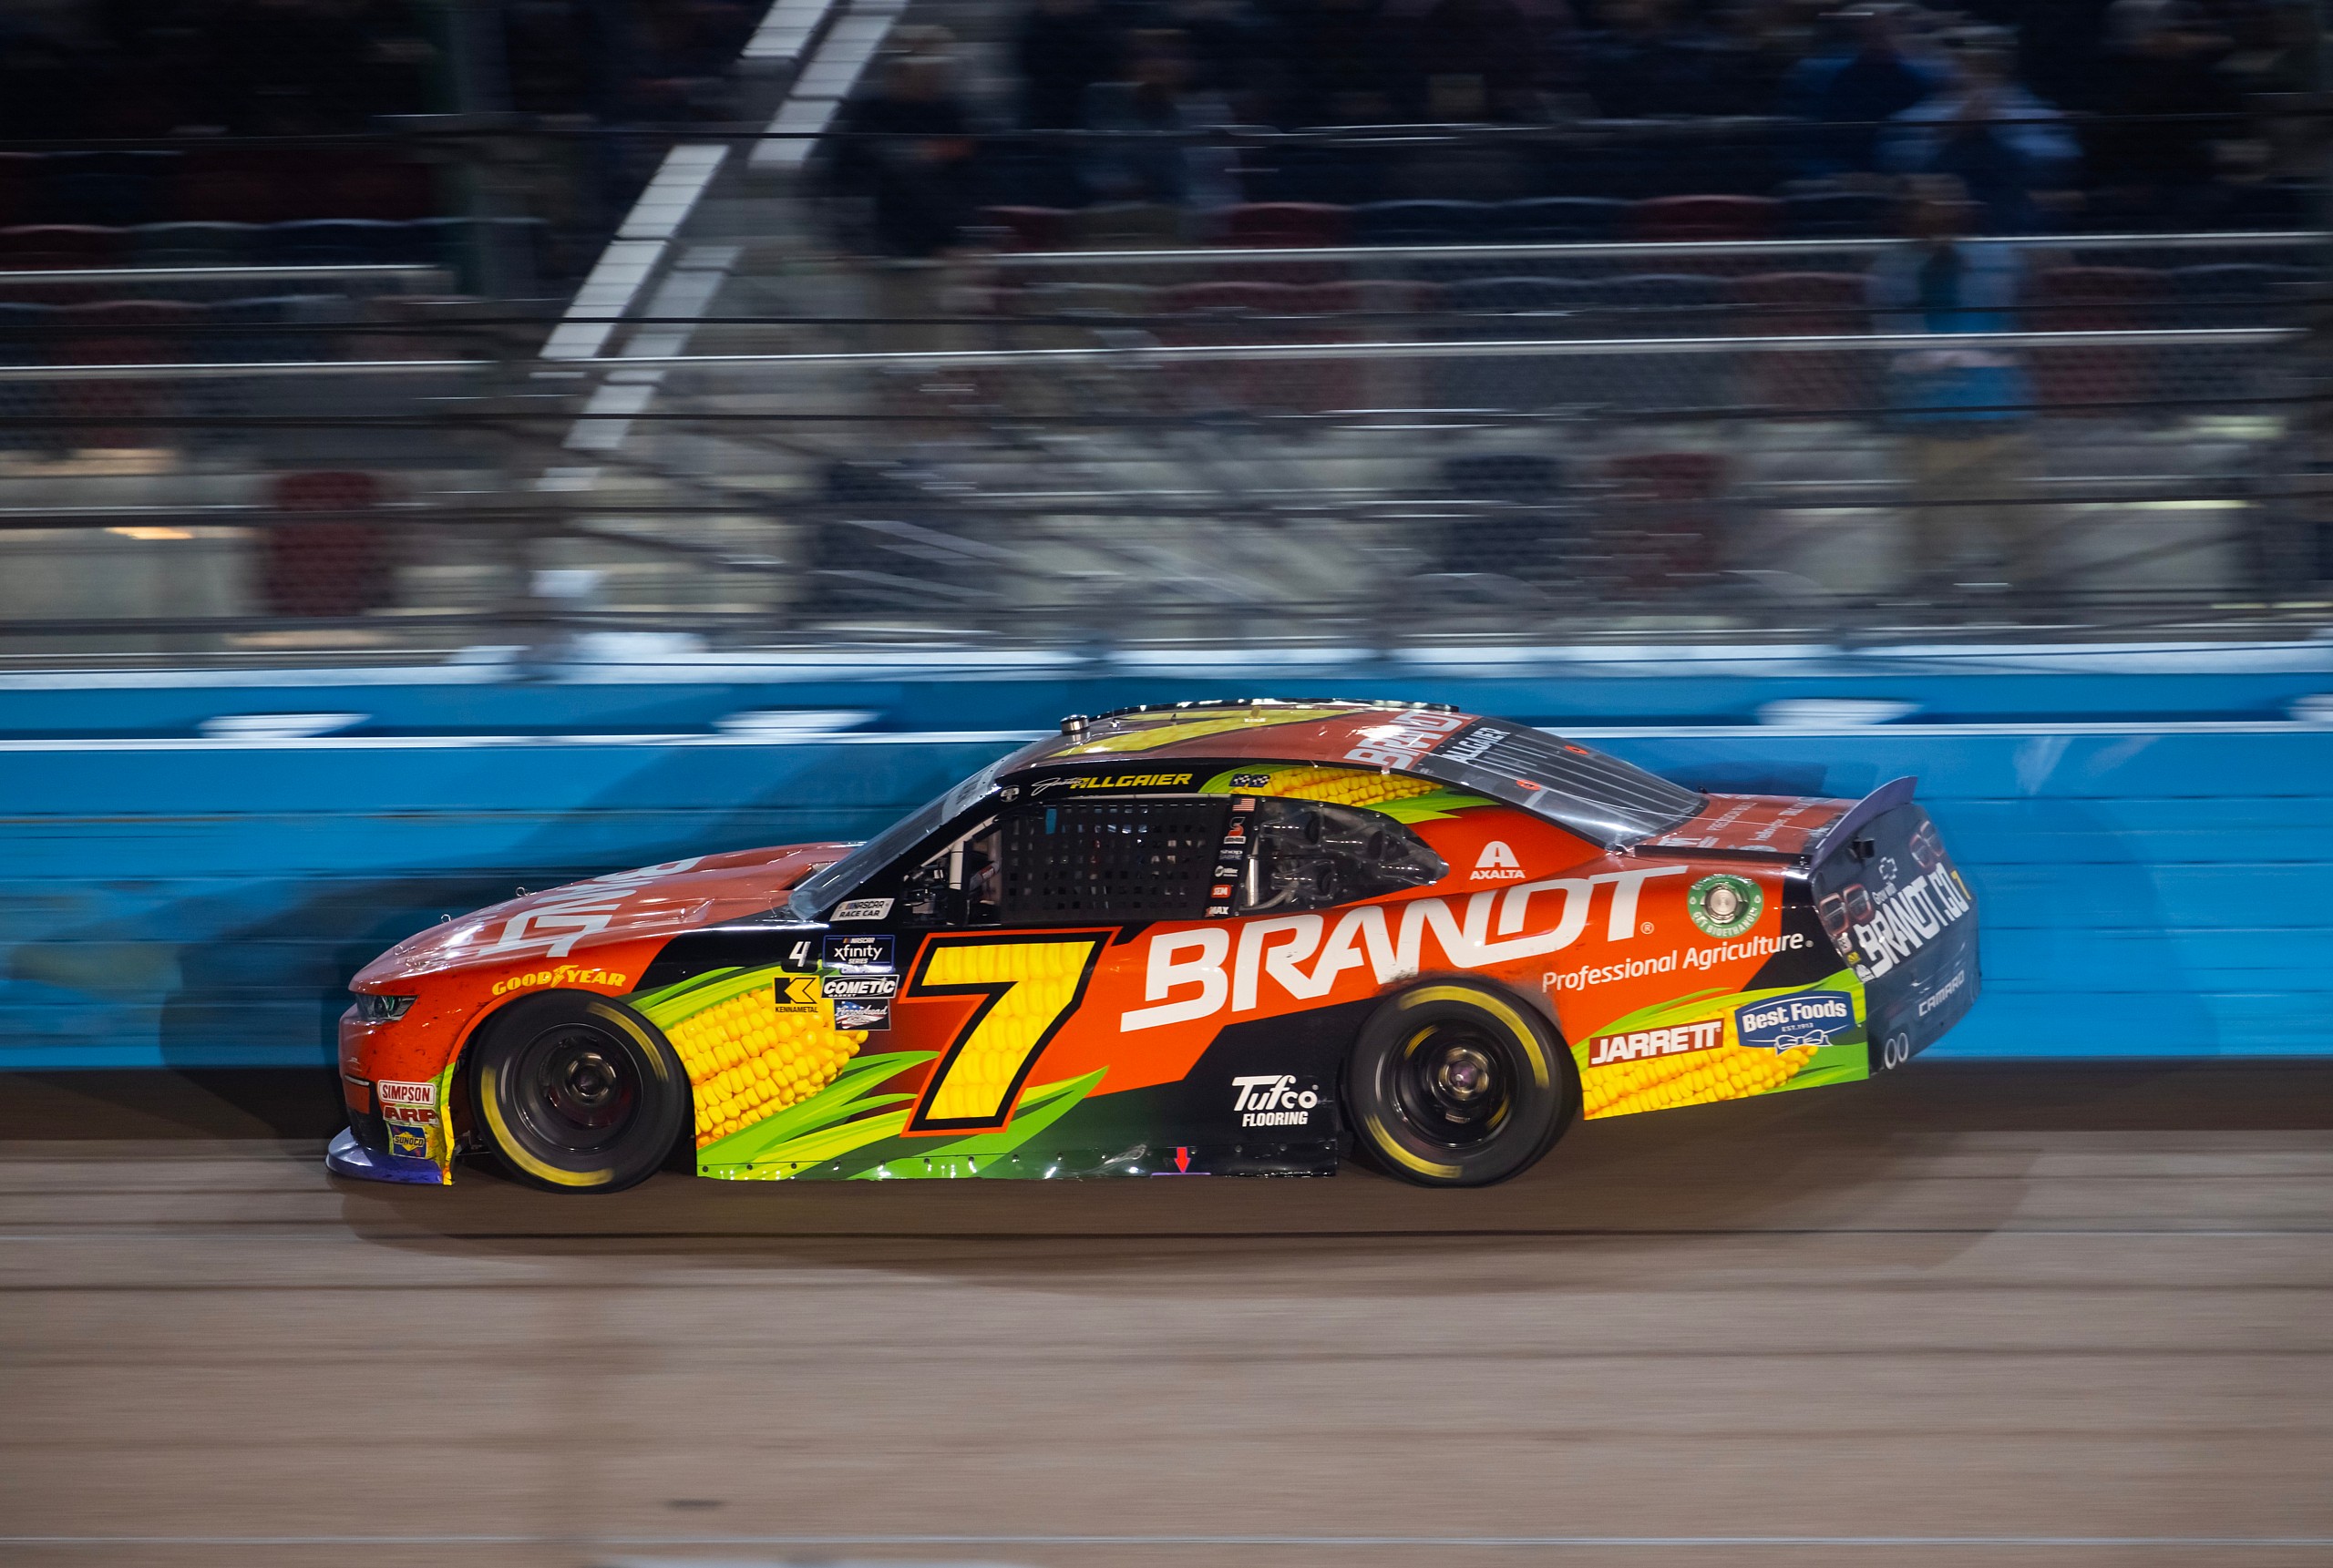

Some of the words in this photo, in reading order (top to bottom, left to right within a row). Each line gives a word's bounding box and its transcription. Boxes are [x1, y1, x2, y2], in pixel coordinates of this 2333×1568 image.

[1440, 727, 1513, 764] ALLGAIER
[1069, 774, 1194, 789] ALLGAIER
[1469, 869, 1526, 880] AXALTA
[852, 901, 885, 909] NASCAR
[788, 941, 811, 968] 4
[833, 944, 884, 961] xfinity
[1120, 866, 1688, 1032] BRANDT
[1542, 950, 1677, 993] Professional
[824, 980, 896, 995] COMETIC
[1918, 969, 1965, 1017] CAMARO
[1742, 1007, 1790, 1033] Best
[1791, 999, 1847, 1021] Foods
[908, 932, 1112, 1132] 7
[1590, 1020, 1722, 1065] JARRETT
[382, 1083, 431, 1102] SIMPSON
[1231, 1075, 1319, 1112] Tufco
[384, 1106, 437, 1122] ARP
[1241, 1111, 1310, 1128] FLOORING
[394, 1135, 425, 1147] SUNOCO
